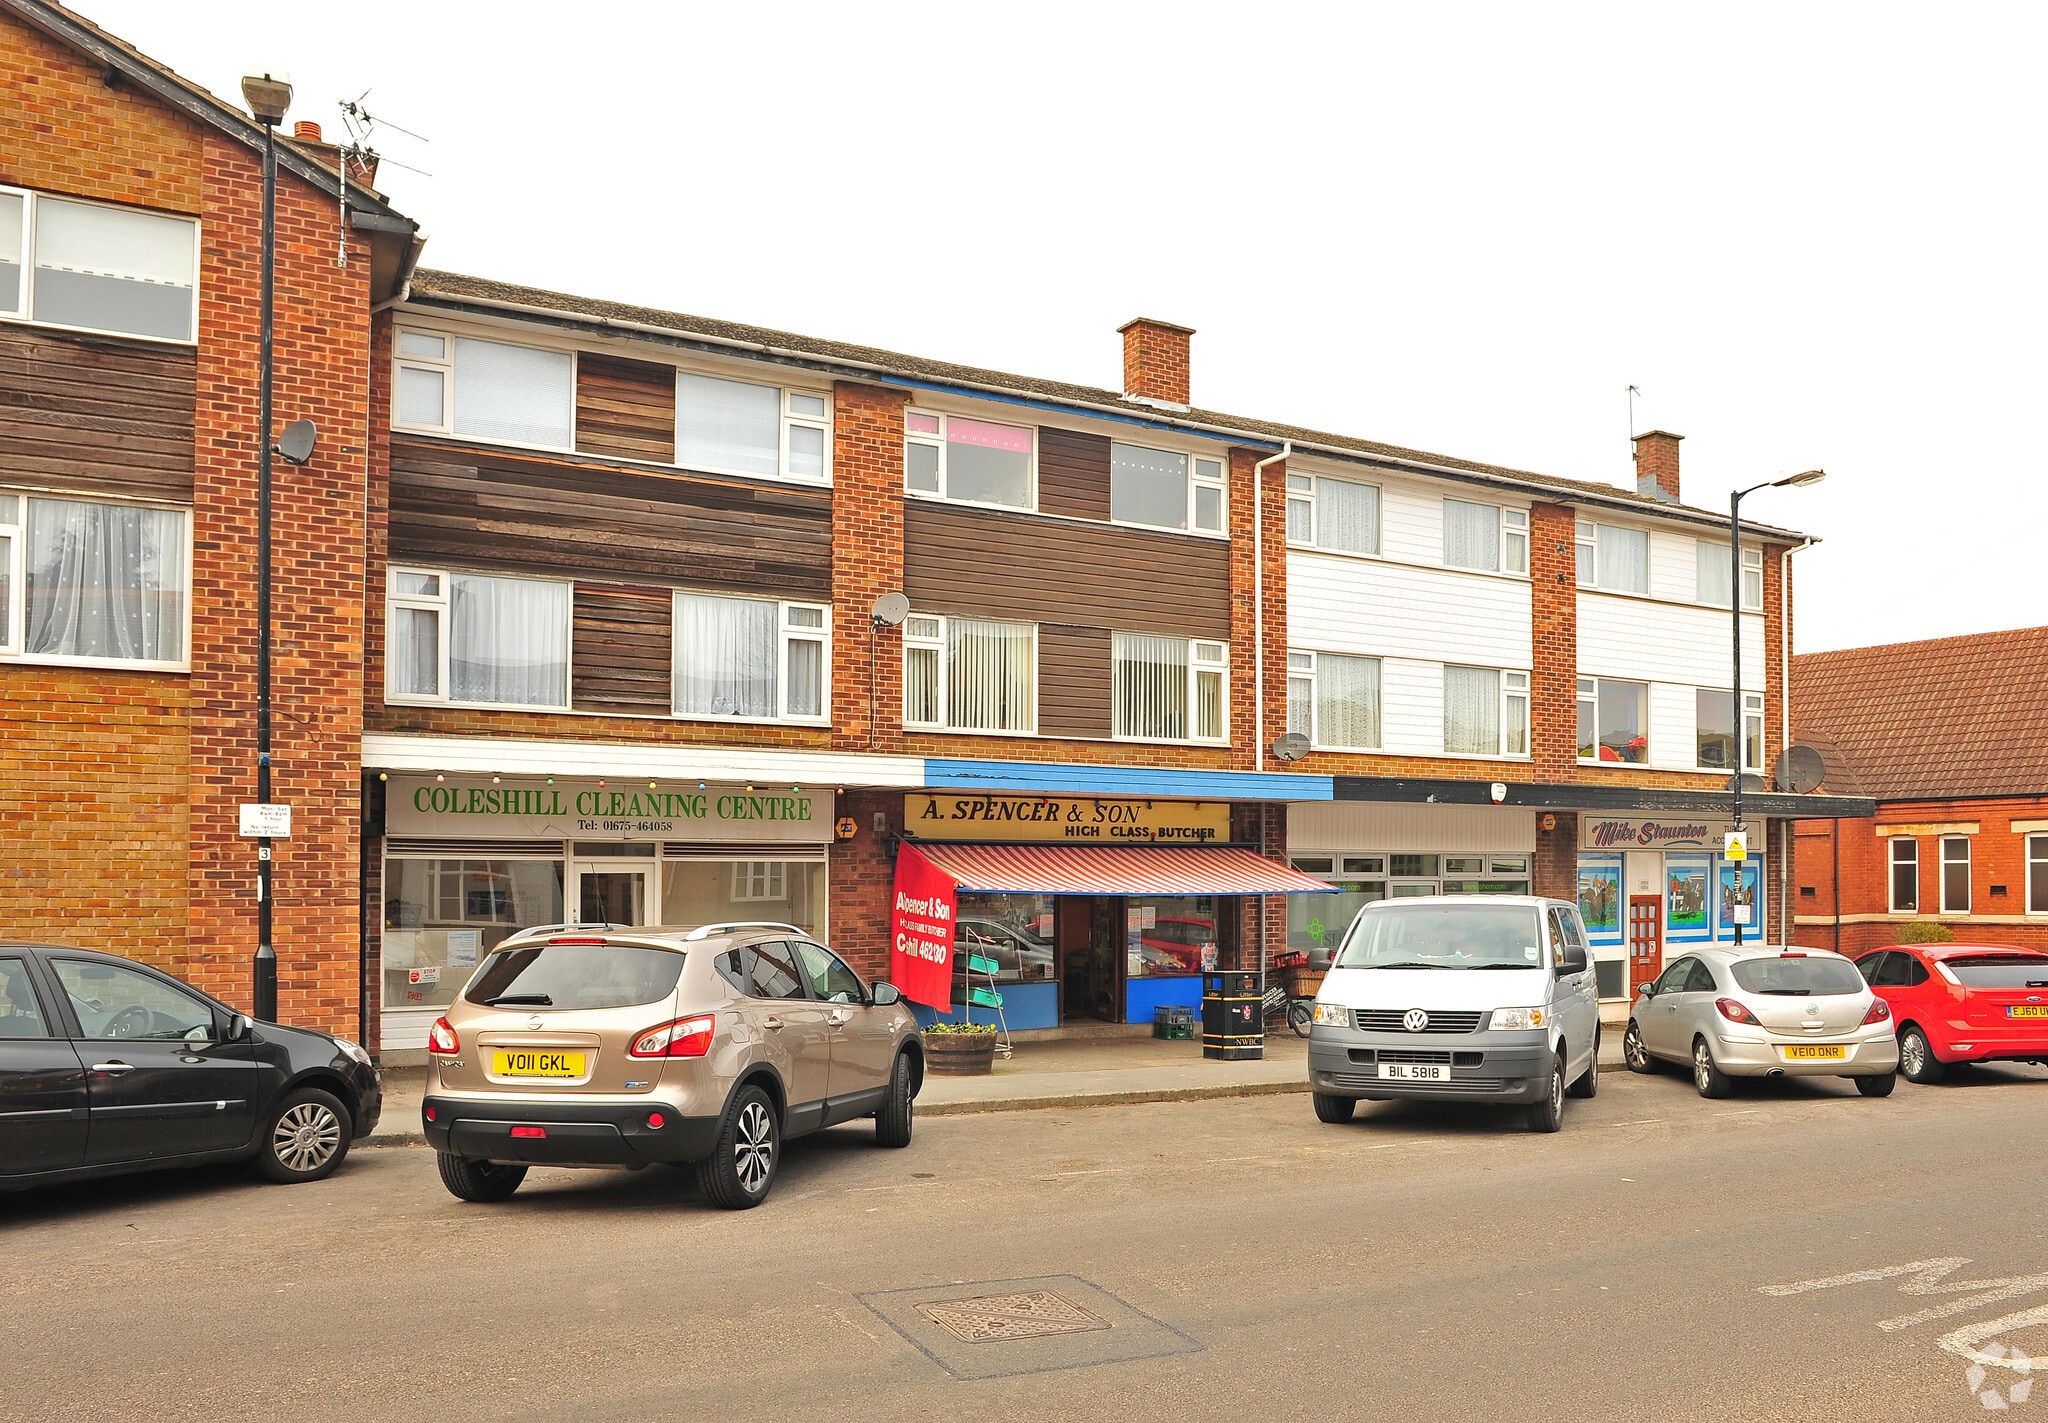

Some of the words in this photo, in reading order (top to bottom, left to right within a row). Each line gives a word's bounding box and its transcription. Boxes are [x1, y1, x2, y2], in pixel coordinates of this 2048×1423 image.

[413, 786, 568, 816] COLESHILL
[575, 791, 708, 819] CLEANING
[716, 794, 812, 821] CENTRE
[920, 800, 944, 819] A.
[951, 801, 1060, 822] SPENCER
[1066, 803, 1084, 822] &
[1094, 804, 1142, 824] SON
[577, 820, 598, 831] Tel:
[602, 820, 673, 832] 01675-464058
[1064, 825, 1100, 837] HIGH
[1110, 826, 1150, 838] CLASS
[1158, 827, 1216, 839] BUTCHER
[1592, 821, 1637, 846] Mike
[1637, 822, 1708, 845] Staunton
[261, 849, 268, 859] 3
[928, 896, 934, 918] &
[934, 898, 950, 920] Son
[2013, 1007, 2038, 1016] EJ60
[1235, 1038, 1259, 1046] NWBC
[1791, 1047, 1816, 1057] VE10
[1818, 1047, 1839, 1057] ONR
[507, 1054, 535, 1070] VO11
[540, 1055, 570, 1071] GKL
[1389, 1066, 1408, 1078] BIL
[1412, 1066, 1440, 1079] 5818
